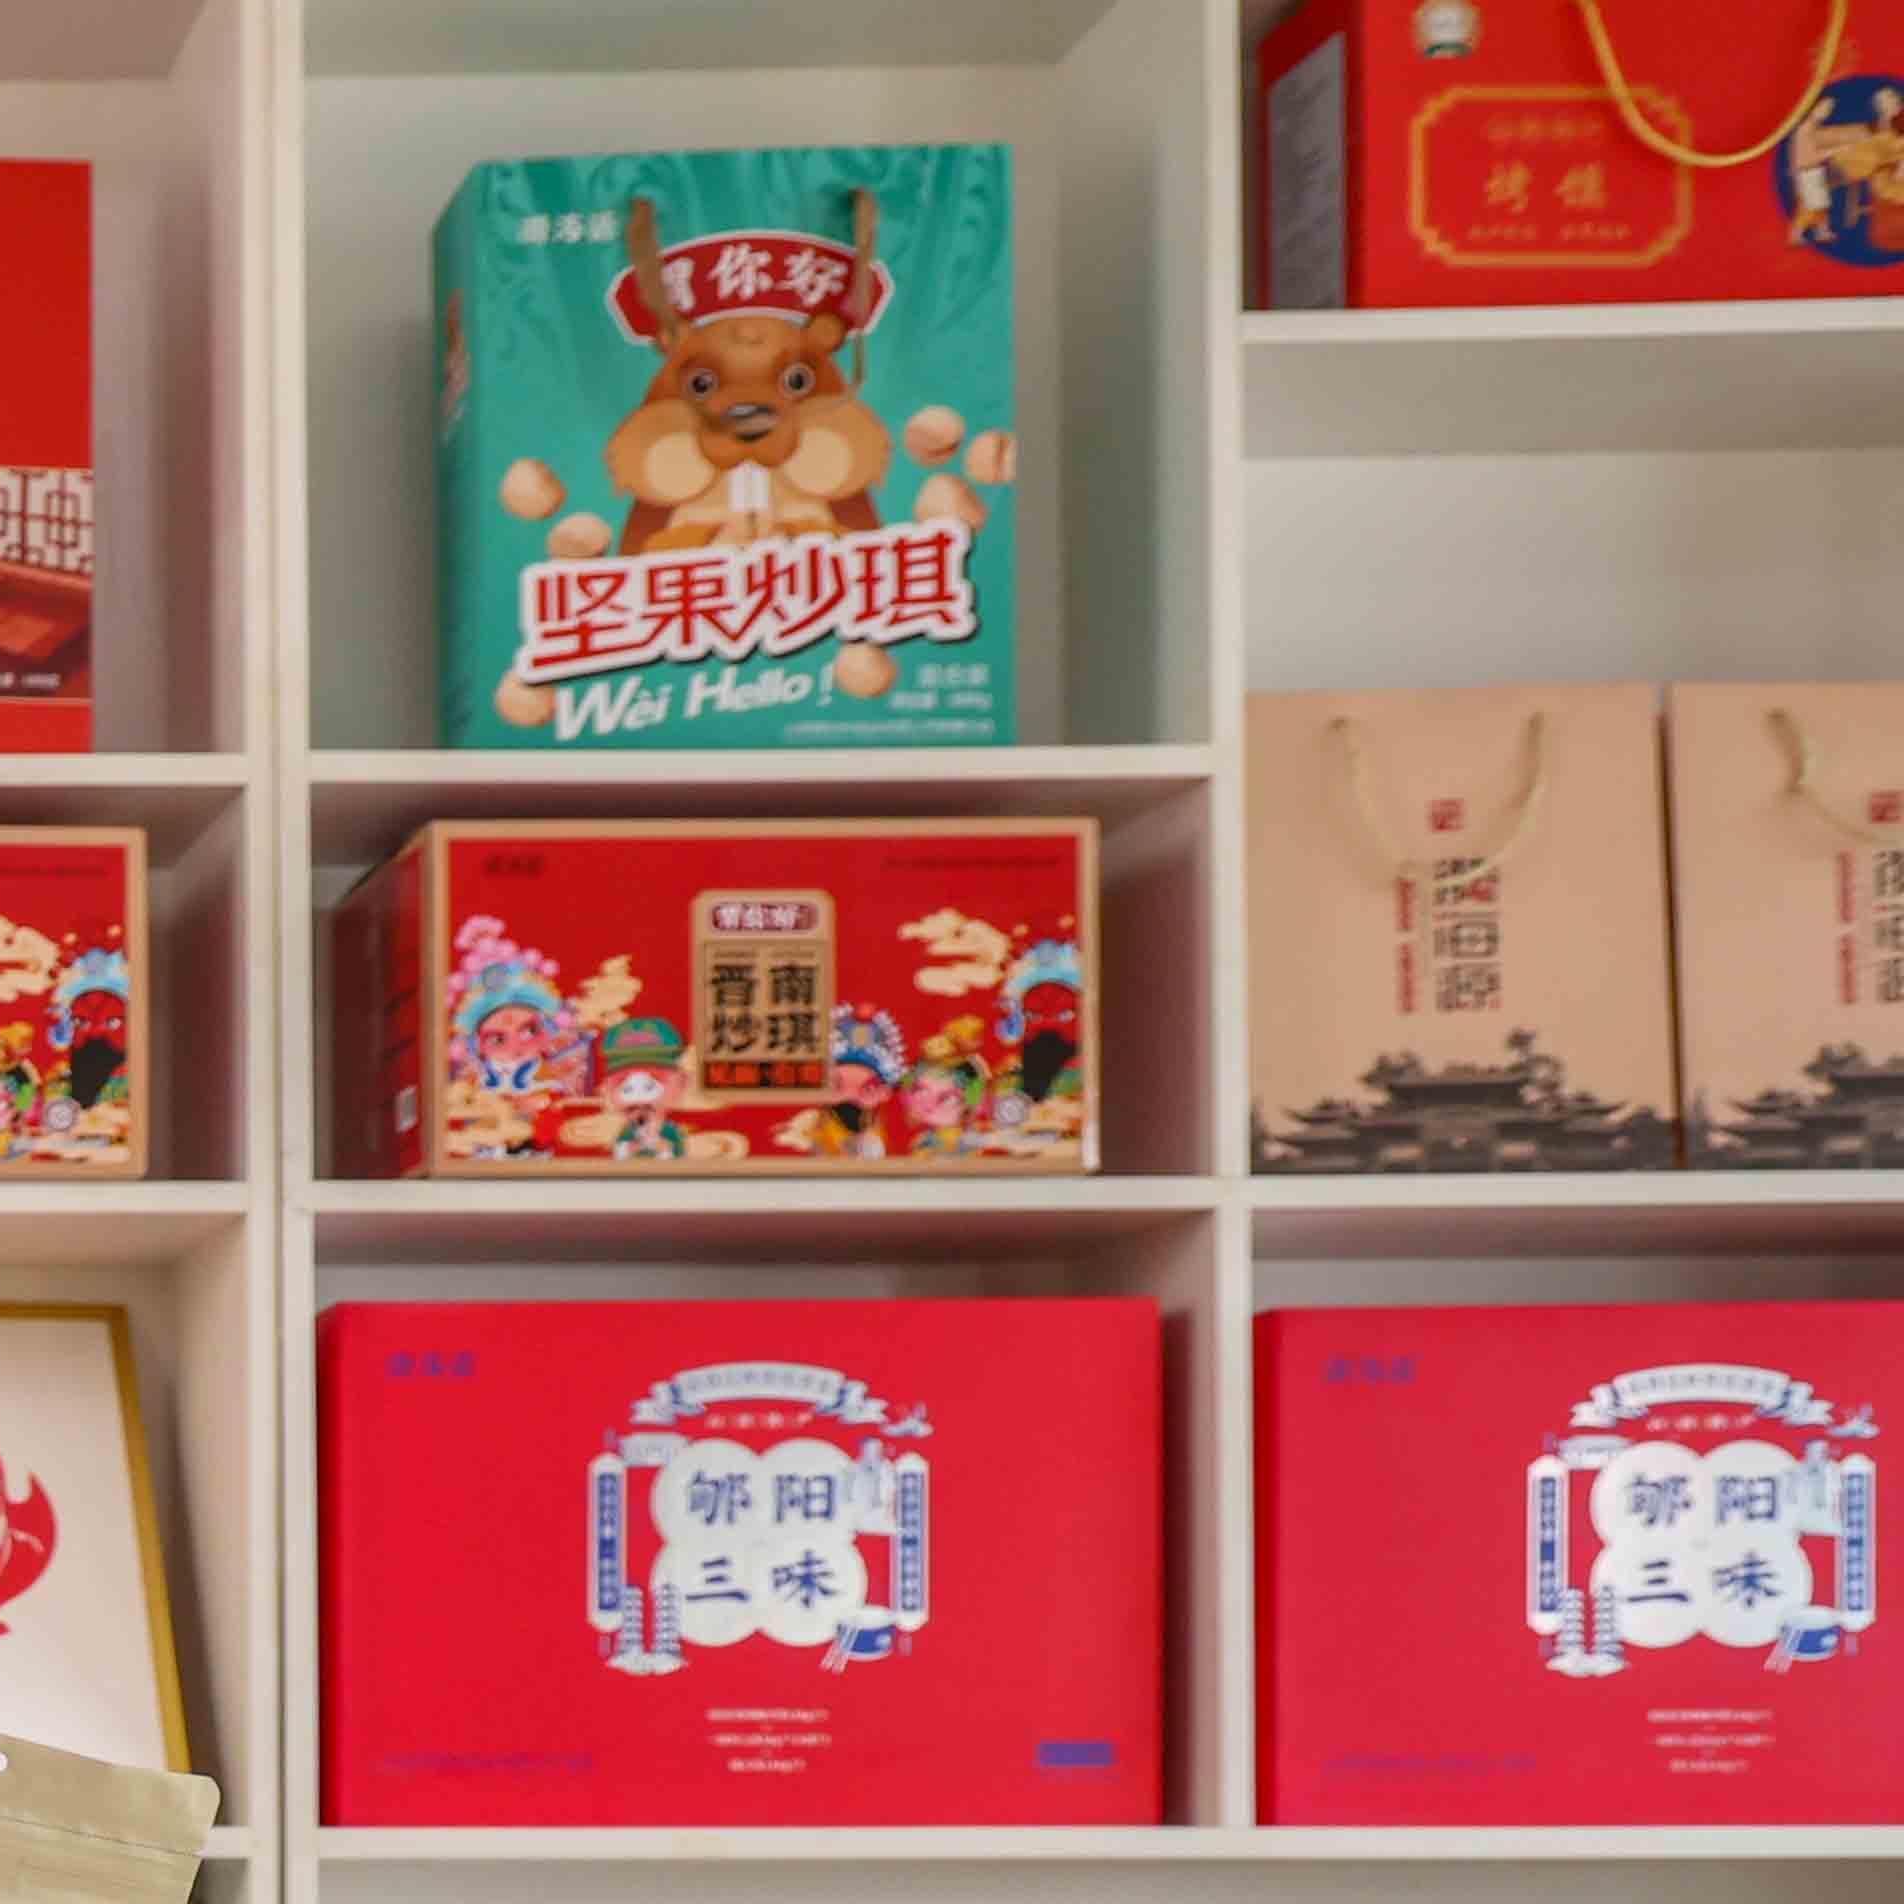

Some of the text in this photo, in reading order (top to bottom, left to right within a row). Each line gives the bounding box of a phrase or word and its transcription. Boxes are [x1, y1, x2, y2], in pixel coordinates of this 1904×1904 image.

[532, 530, 958, 669] 坚果炒琪
[710, 964, 818, 1005] 晋南
[710, 1013, 821, 1055] 炒琪
[686, 1551, 836, 1607] 三味
[1627, 1553, 1780, 1606] 三味
